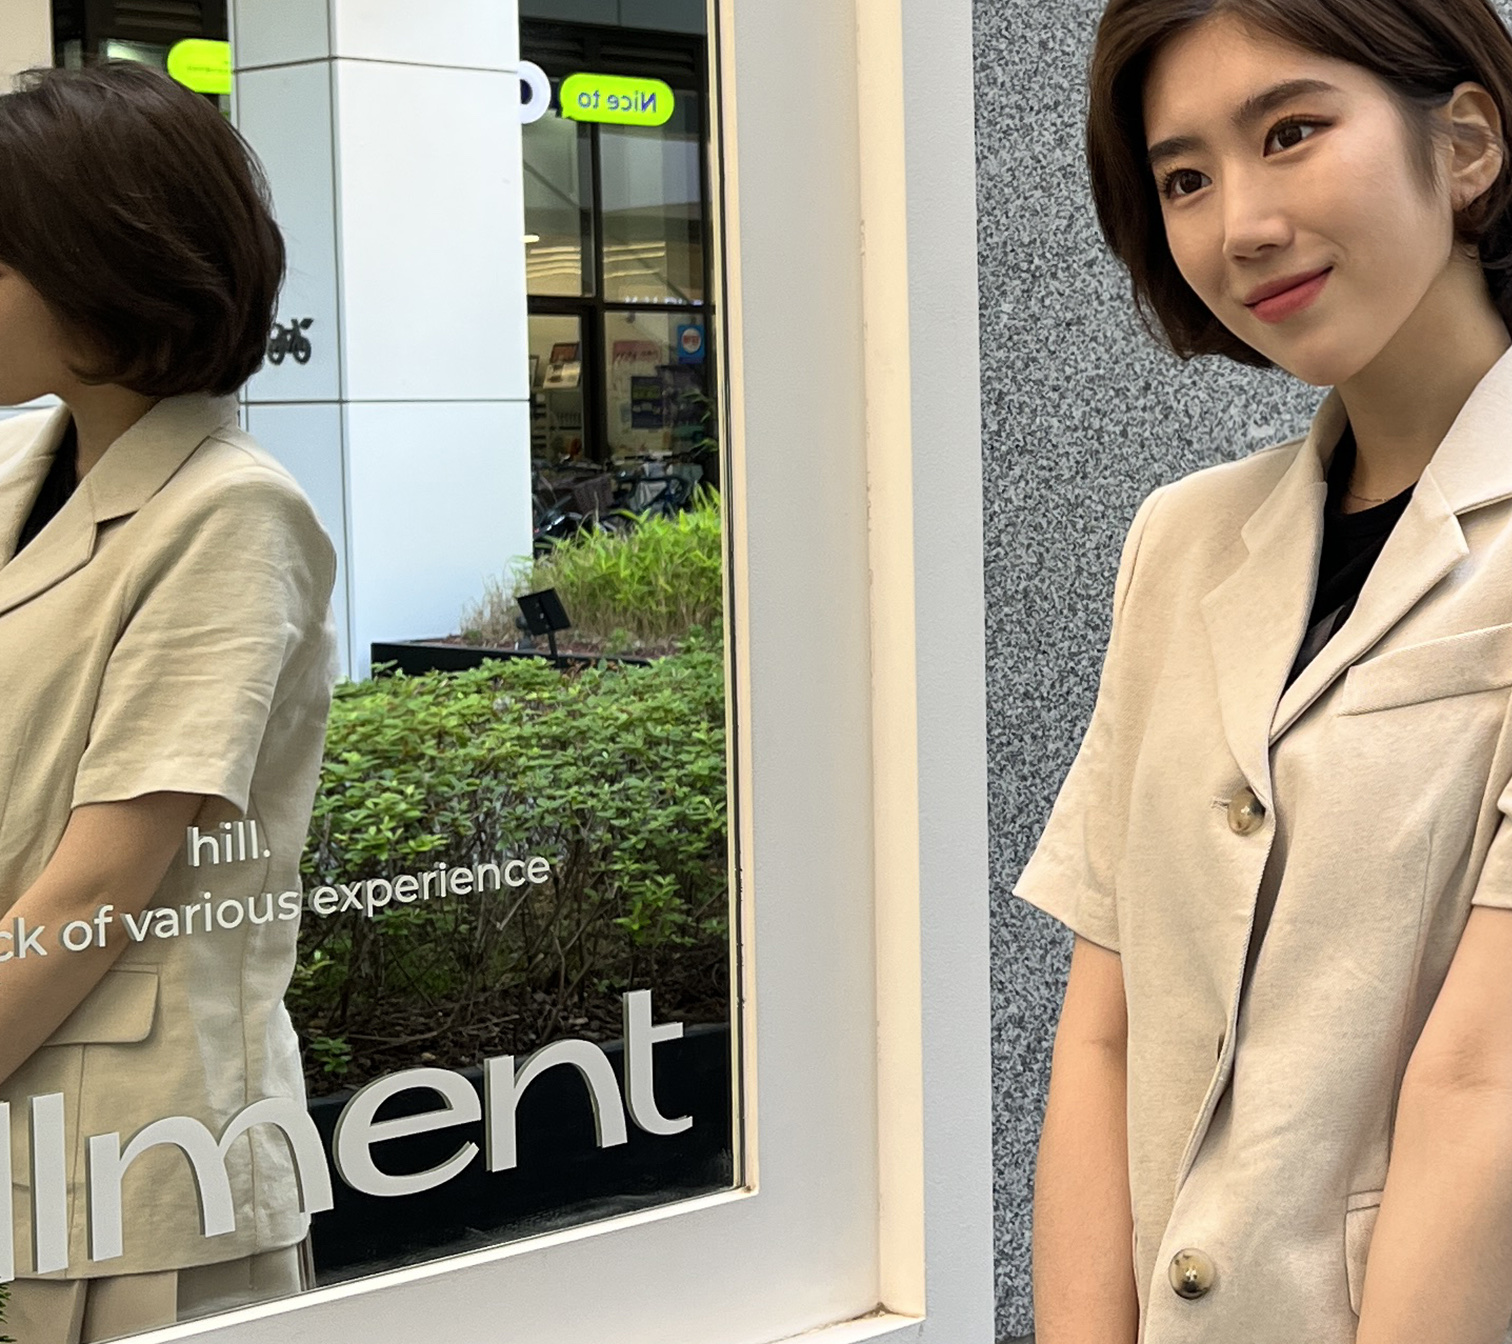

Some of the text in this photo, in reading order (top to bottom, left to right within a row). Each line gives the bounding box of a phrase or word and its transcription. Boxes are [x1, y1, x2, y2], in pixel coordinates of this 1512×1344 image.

[187, 819, 271, 867] hill.
[59, 904, 114, 952] of
[121, 890, 301, 943] various
[309, 855, 551, 919] experience
